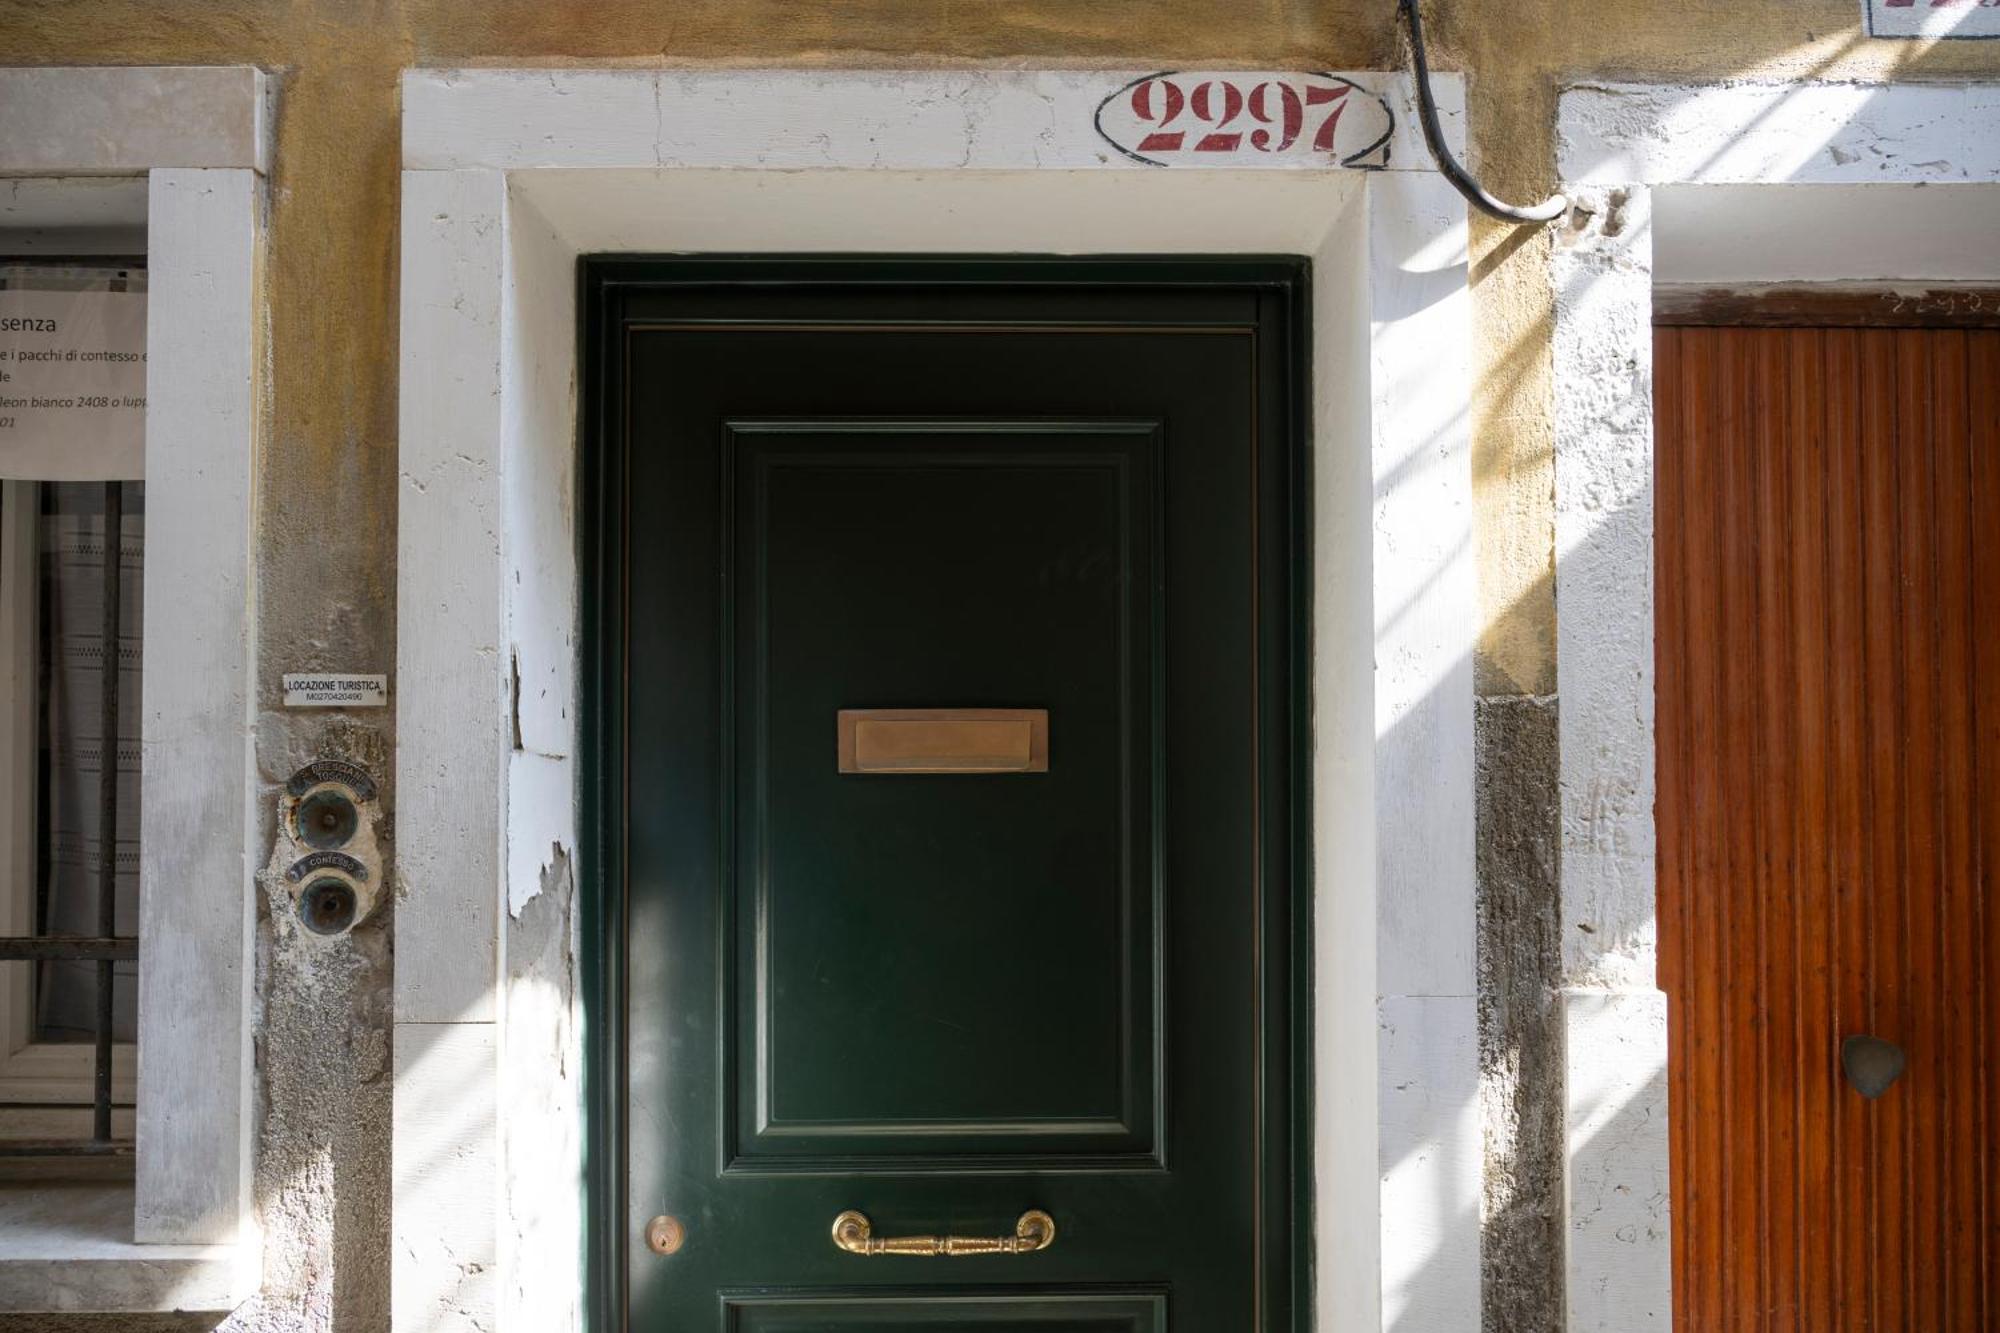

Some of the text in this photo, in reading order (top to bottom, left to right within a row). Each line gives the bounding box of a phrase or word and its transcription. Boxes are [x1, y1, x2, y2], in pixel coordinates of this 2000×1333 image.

[1131, 80, 1353, 152] 2297
[1, 317, 57, 332] senza
[18, 349, 62, 363] pacchi
[66, 350, 77, 361] di
[80, 351, 139, 362] contesso
[31, 396, 73, 408] bianco
[77, 396, 109, 408] 2408
[111, 399, 120, 408] o
[288, 680, 381, 691] LOCAZIONE TURISTICA
[309, 855, 355, 871] CONTESSO
